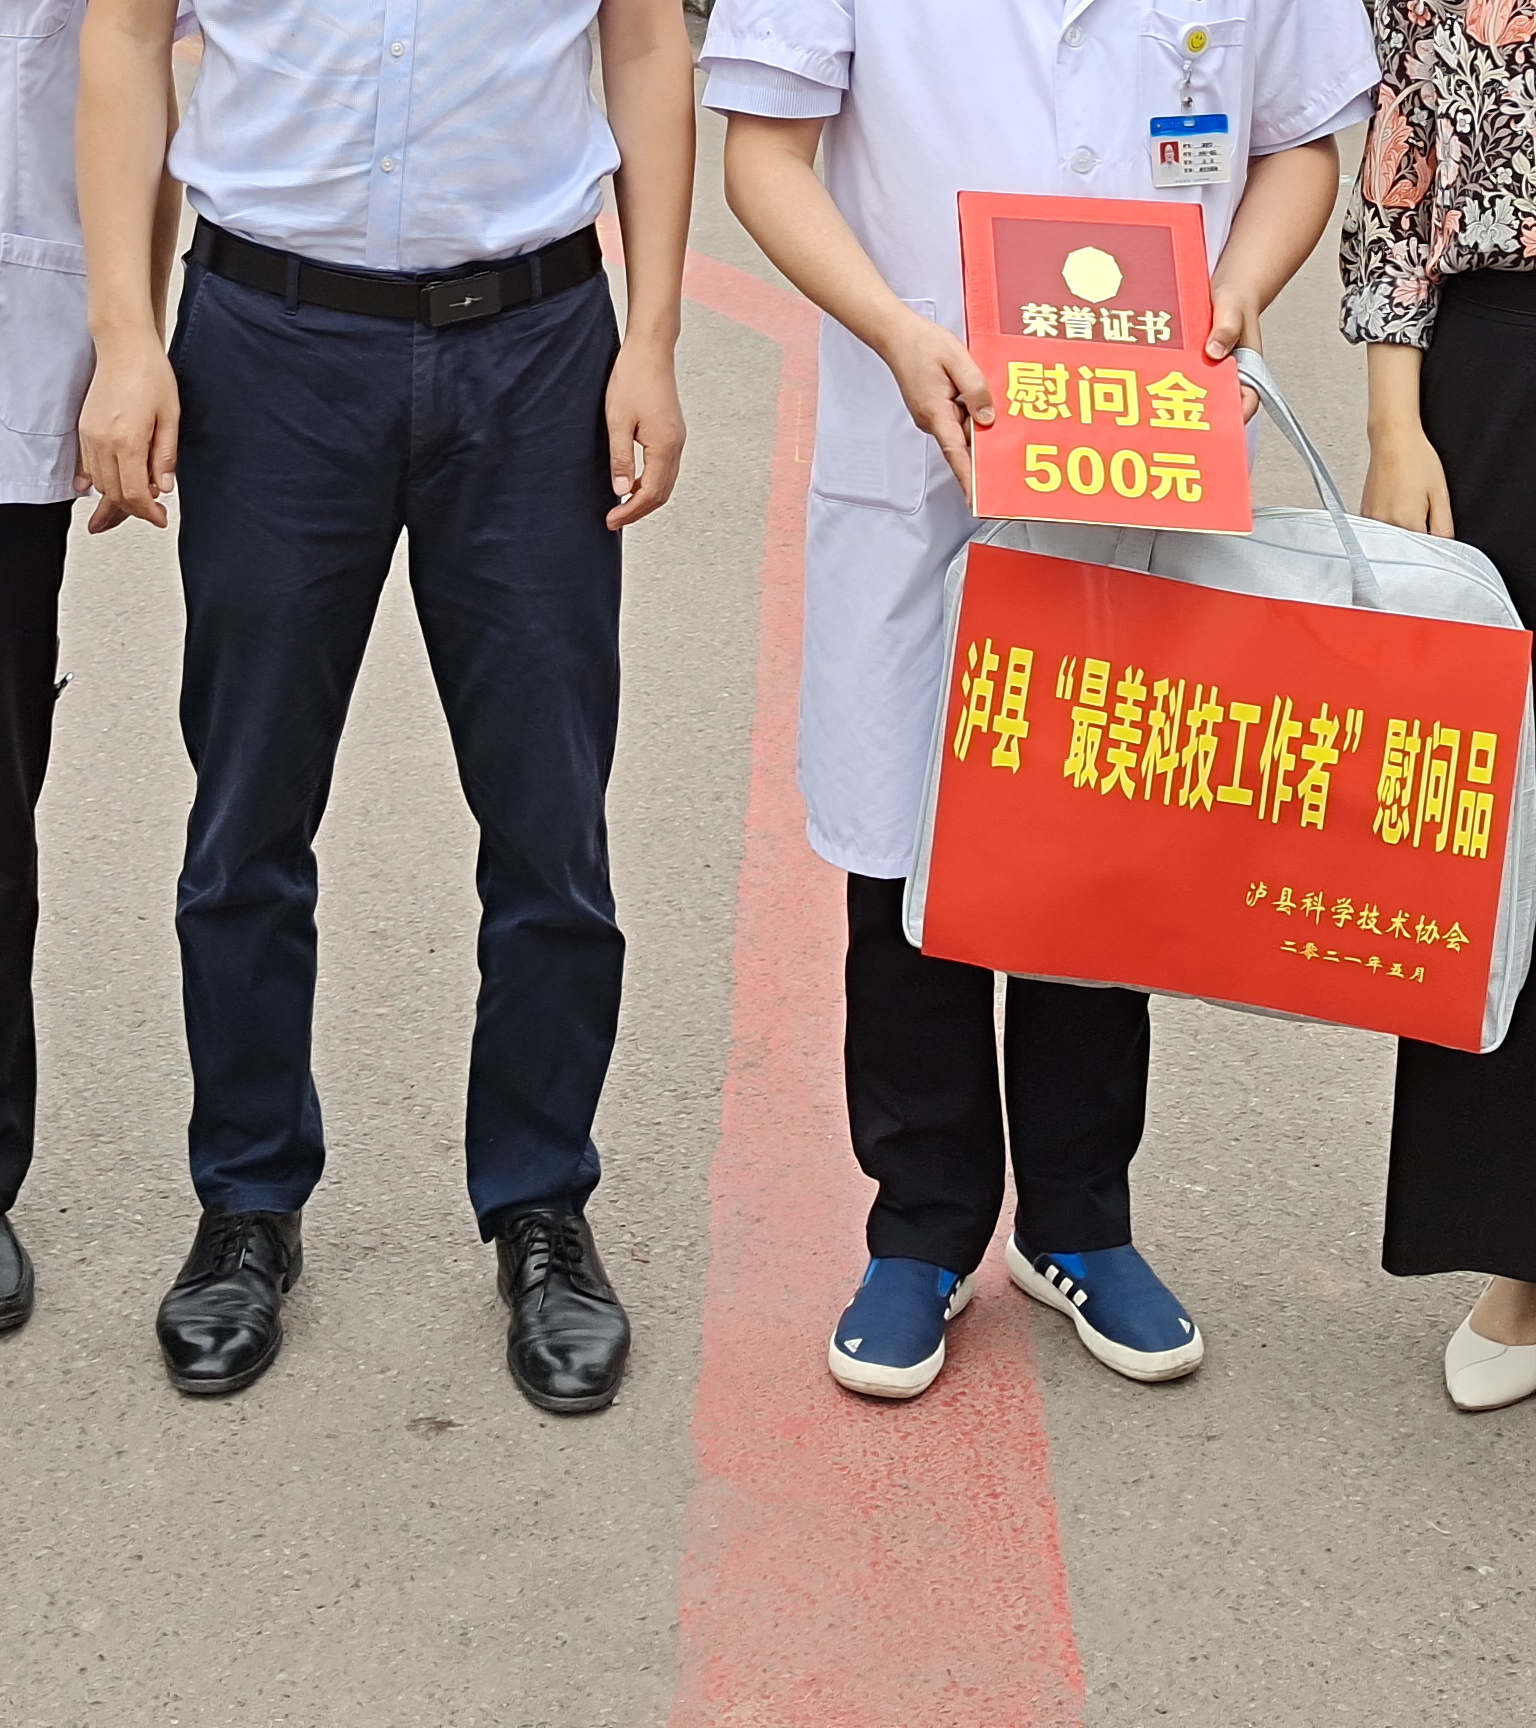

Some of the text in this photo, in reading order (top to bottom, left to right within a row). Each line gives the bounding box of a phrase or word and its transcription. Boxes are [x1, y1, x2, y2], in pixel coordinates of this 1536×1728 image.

[1020, 302, 1172, 344] 荣誉证书
[1005, 360, 1211, 431] 慰问金
[1024, 443, 1204, 503] 500元
[1245, 880, 1471, 954] 泸县科学技术协会
